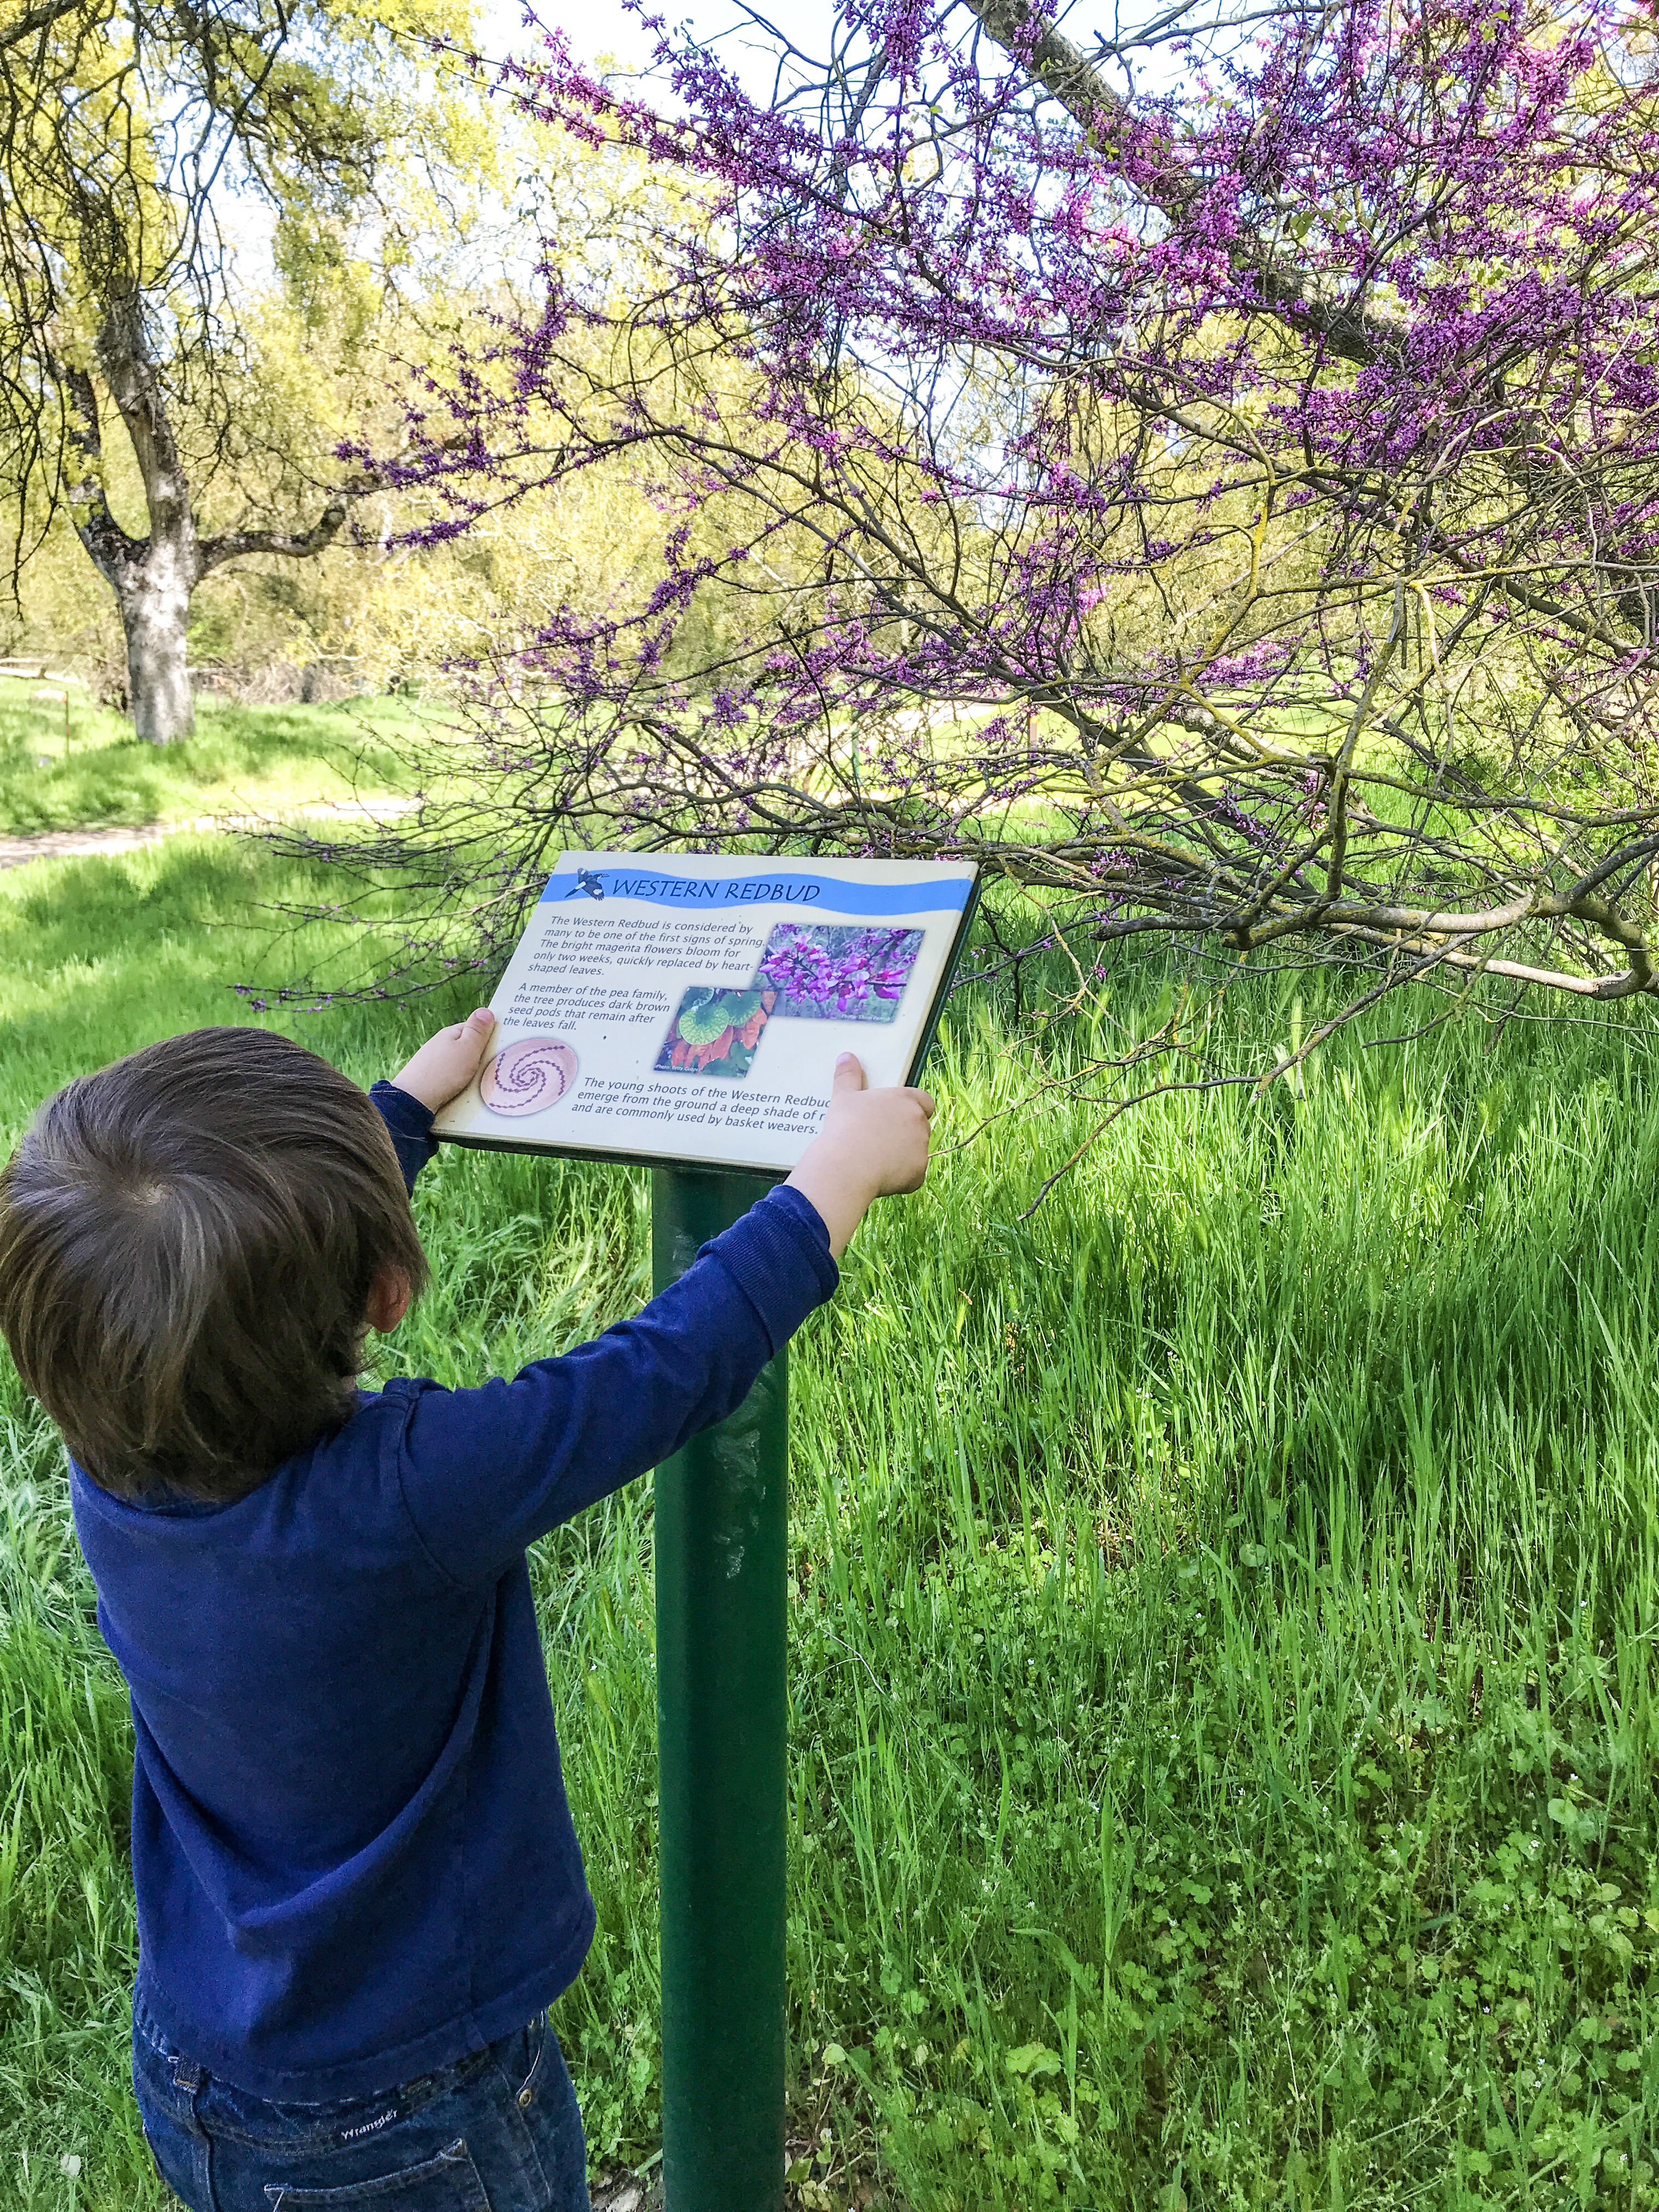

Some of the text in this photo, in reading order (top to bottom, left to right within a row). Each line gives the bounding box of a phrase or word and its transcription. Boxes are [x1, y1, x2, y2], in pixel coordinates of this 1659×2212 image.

[613, 879, 820, 902] WESTERN REDBUD
[551, 916, 753, 935] The Western Redbud is considered by
[540, 939, 741, 957] The bright magenta flowers bloom for
[544, 929, 572, 938] many
[574, 930, 585, 938] to
[588, 930, 600, 938] be
[625, 932, 638, 940] of
[639, 932, 656, 941] the
[659, 933, 680, 943] first
[682, 934, 709, 945] signs
[714, 936, 727, 944] of
[728, 937, 765, 948] spring.
[528, 963, 604, 975] shaped leaves.
[533, 951, 753, 971] only two weeks, quickly replaced by heart-
[518, 983, 668, 1001] A member of the pea family,
[514, 994, 669, 1012] the tree produces dark brown
[504, 1017, 577, 1030] the leaves fall.
[509, 1006, 655, 1023] seed pods that remain after
[584, 1077, 604, 1087] The
[608, 1081, 644, 1093] young
[647, 1083, 687, 1095] shoots
[691, 1087, 706, 1096] of
[708, 1087, 727, 1098] the
[731, 1090, 780, 1103] Western
[578, 1092, 619, 1103] emerge
[622, 1093, 649, 1104] from
[653, 1096, 671, 1107] the
[674, 1099, 717, 1110] ground
[731, 1103, 760, 1116] deep
[763, 1106, 799, 1119] shade
[803, 1110, 817, 1120] of
[572, 1103, 593, 1112] and
[616, 1108, 675, 1122] commonly
[677, 1114, 706, 1123] used
[708, 1114, 723, 1127] by
[725, 1116, 764, 1129] basket
[768, 1121, 818, 1135] weavers.
[341, 2109, 397, 2140] Wrangler
